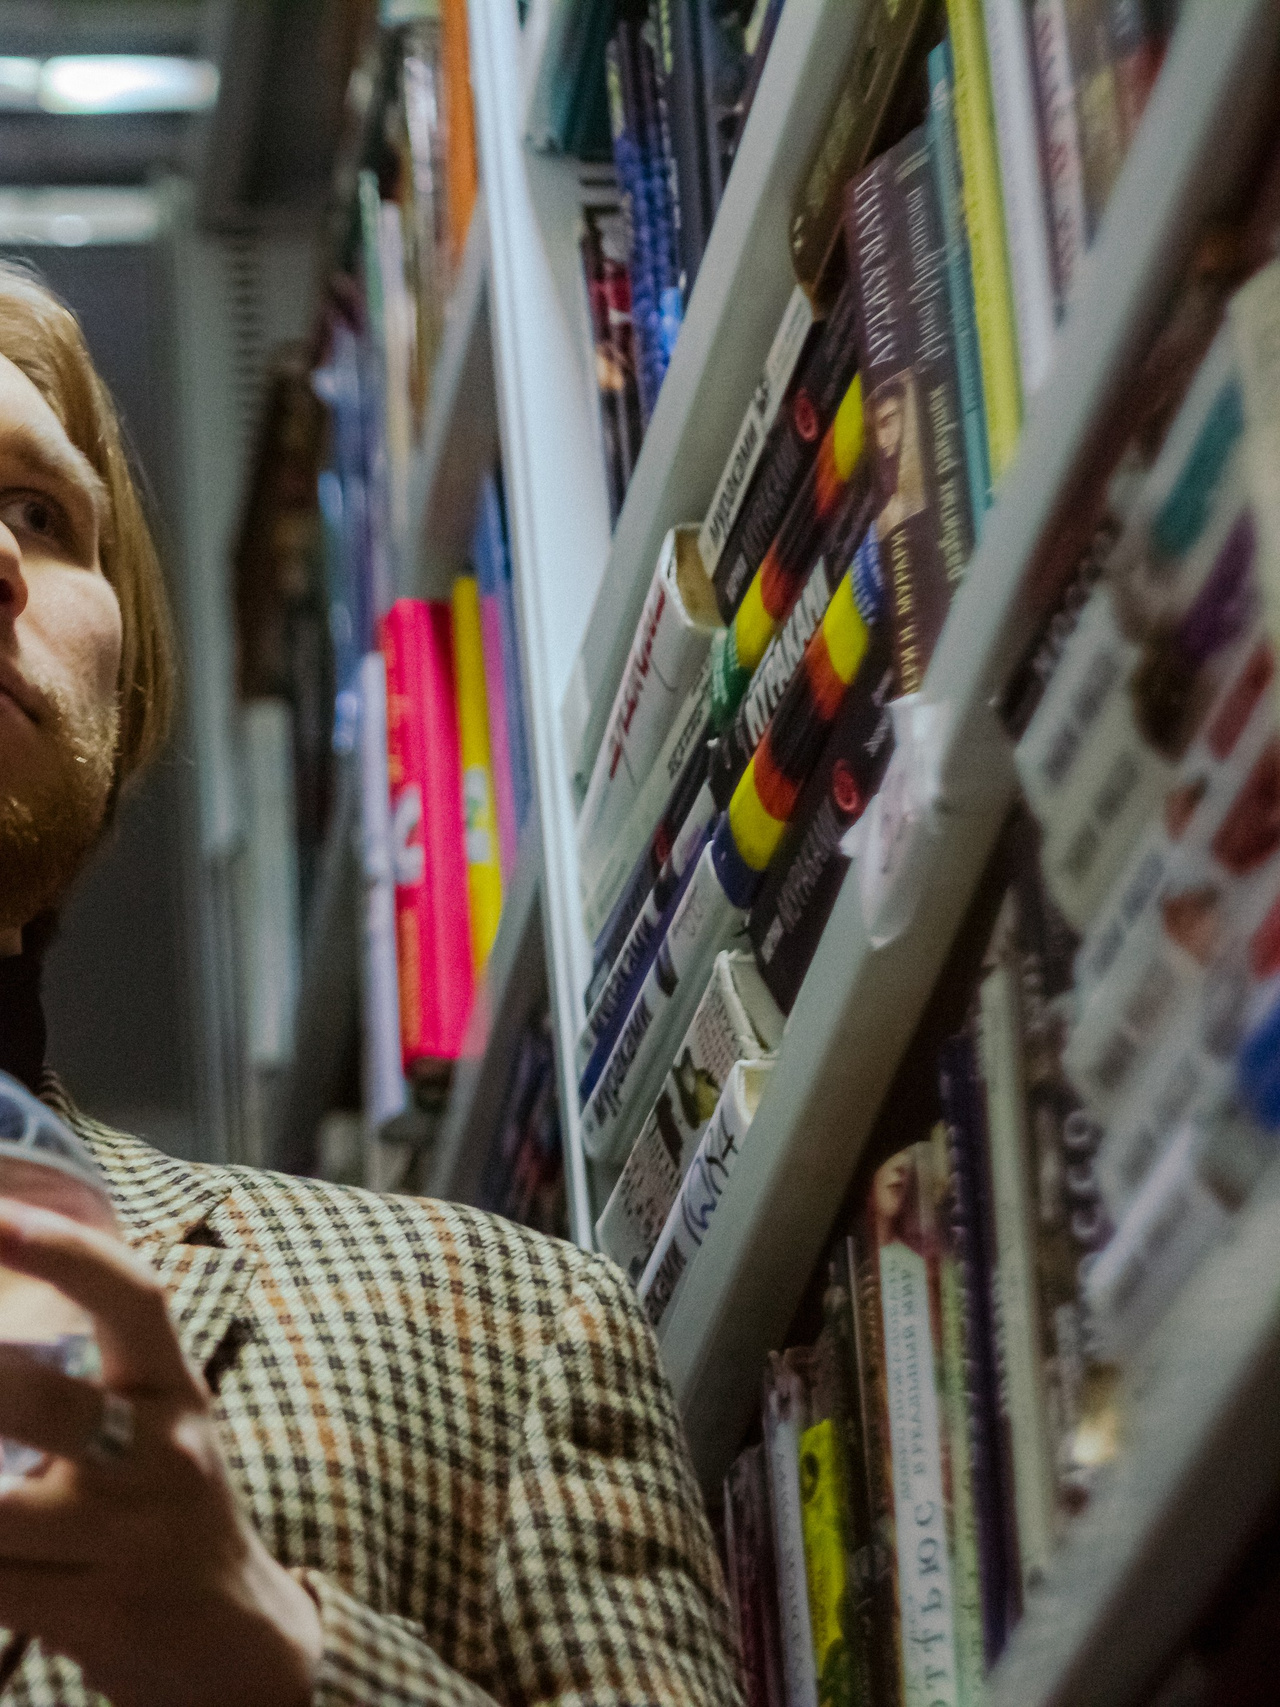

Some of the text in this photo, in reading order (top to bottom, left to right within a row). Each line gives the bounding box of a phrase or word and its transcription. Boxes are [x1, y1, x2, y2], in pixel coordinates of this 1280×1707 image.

[854, 160, 898, 368] АРДЖУМАНД
[906, 186, 950, 305] Муратова
[929, 382, 959, 475] ракушек
[891, 528, 913, 616] МУРАРИ
[899, 1268, 915, 1316] МИР
